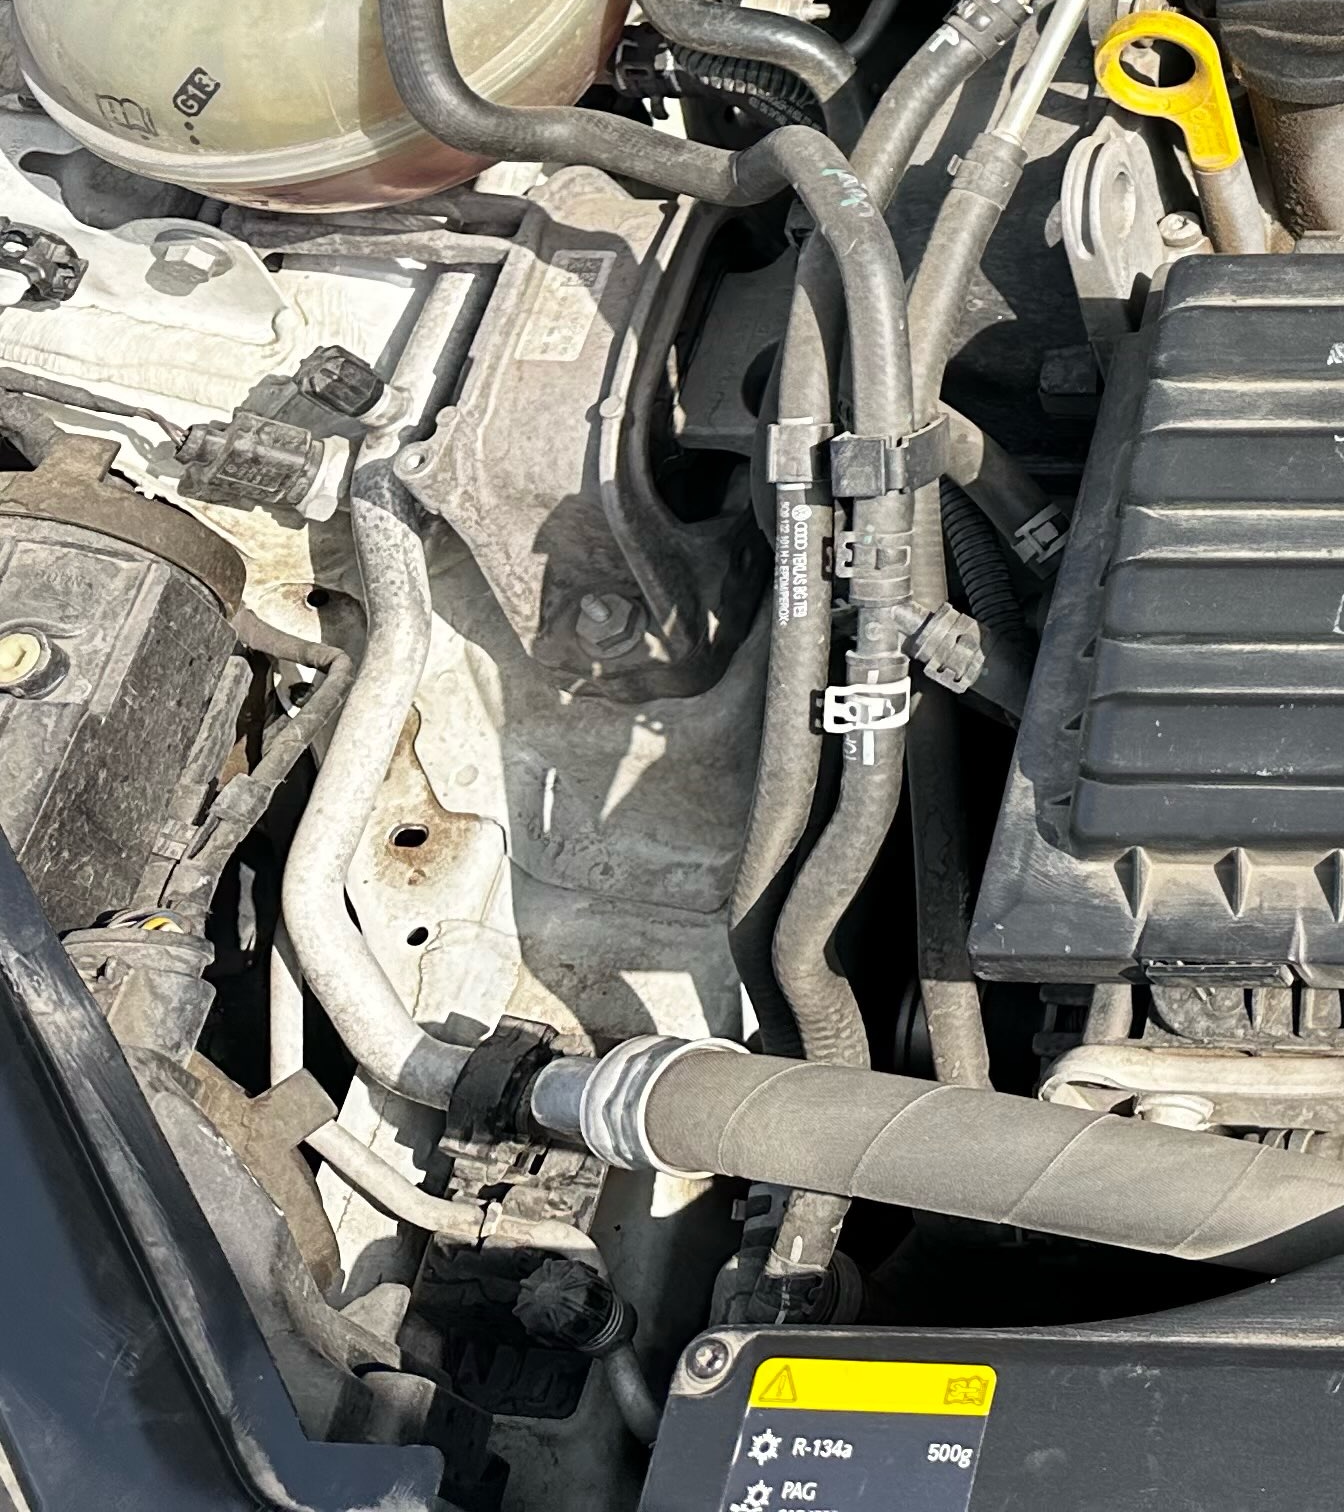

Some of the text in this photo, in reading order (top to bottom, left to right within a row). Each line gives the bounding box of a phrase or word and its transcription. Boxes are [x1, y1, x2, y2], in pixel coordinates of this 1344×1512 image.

[176, 73, 217, 114] G13
[792, 551, 808, 585] TEKLAS
[791, 1437, 974, 1469] R-134a 500g
[780, 1481, 818, 1501] PAG
